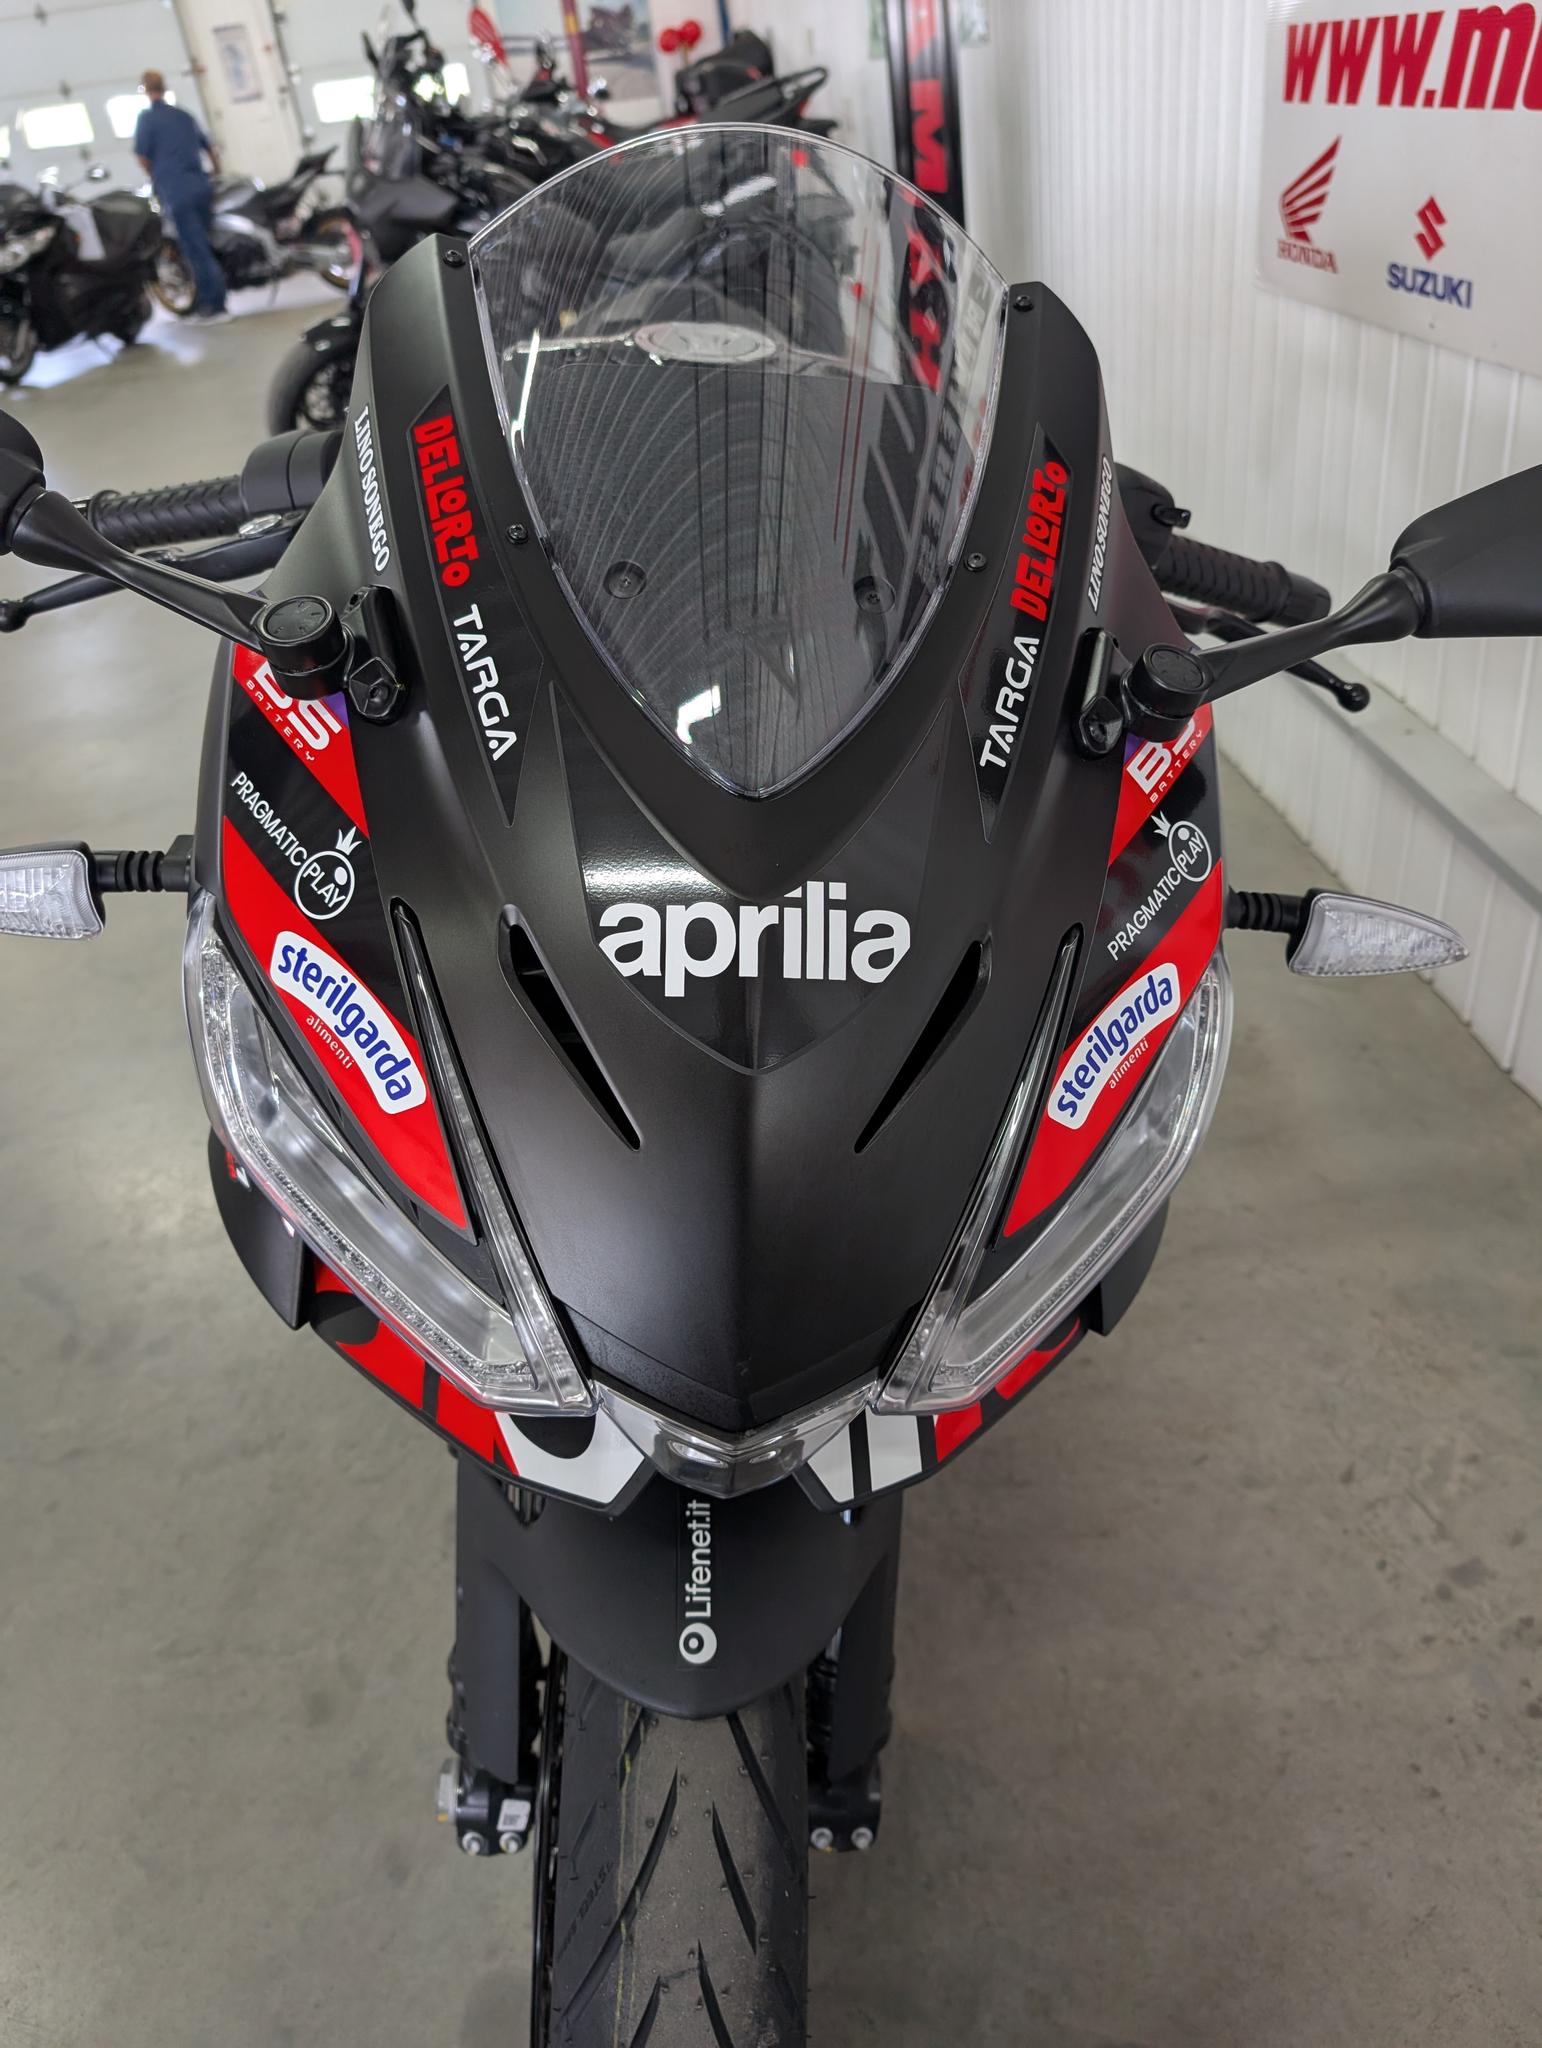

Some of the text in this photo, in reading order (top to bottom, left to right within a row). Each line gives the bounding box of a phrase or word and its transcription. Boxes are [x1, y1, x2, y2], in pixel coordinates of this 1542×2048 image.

[1283, 3, 1542, 111] www.m
[1277, 240, 1339, 274] HONDA
[1387, 262, 1473, 309] SUZUKI
[246, 678, 316, 762] BATTERY
[452, 603, 518, 762] TARGA
[979, 635, 1041, 769] TARGA
[1149, 728, 1204, 804] BATTERY
[230, 771, 346, 909] PRAGMATIC PLAY
[1106, 829, 1206, 962] PRAGMATIC PLAY
[597, 879, 911, 998] aprilia
[277, 943, 413, 1102] sterilgarda
[305, 1014, 357, 1070] alimenti
[1057, 975, 1173, 1118] sterilgarda
[1107, 1037, 1150, 1091] alimenti
[684, 1500, 712, 1619] Lifenet.it
